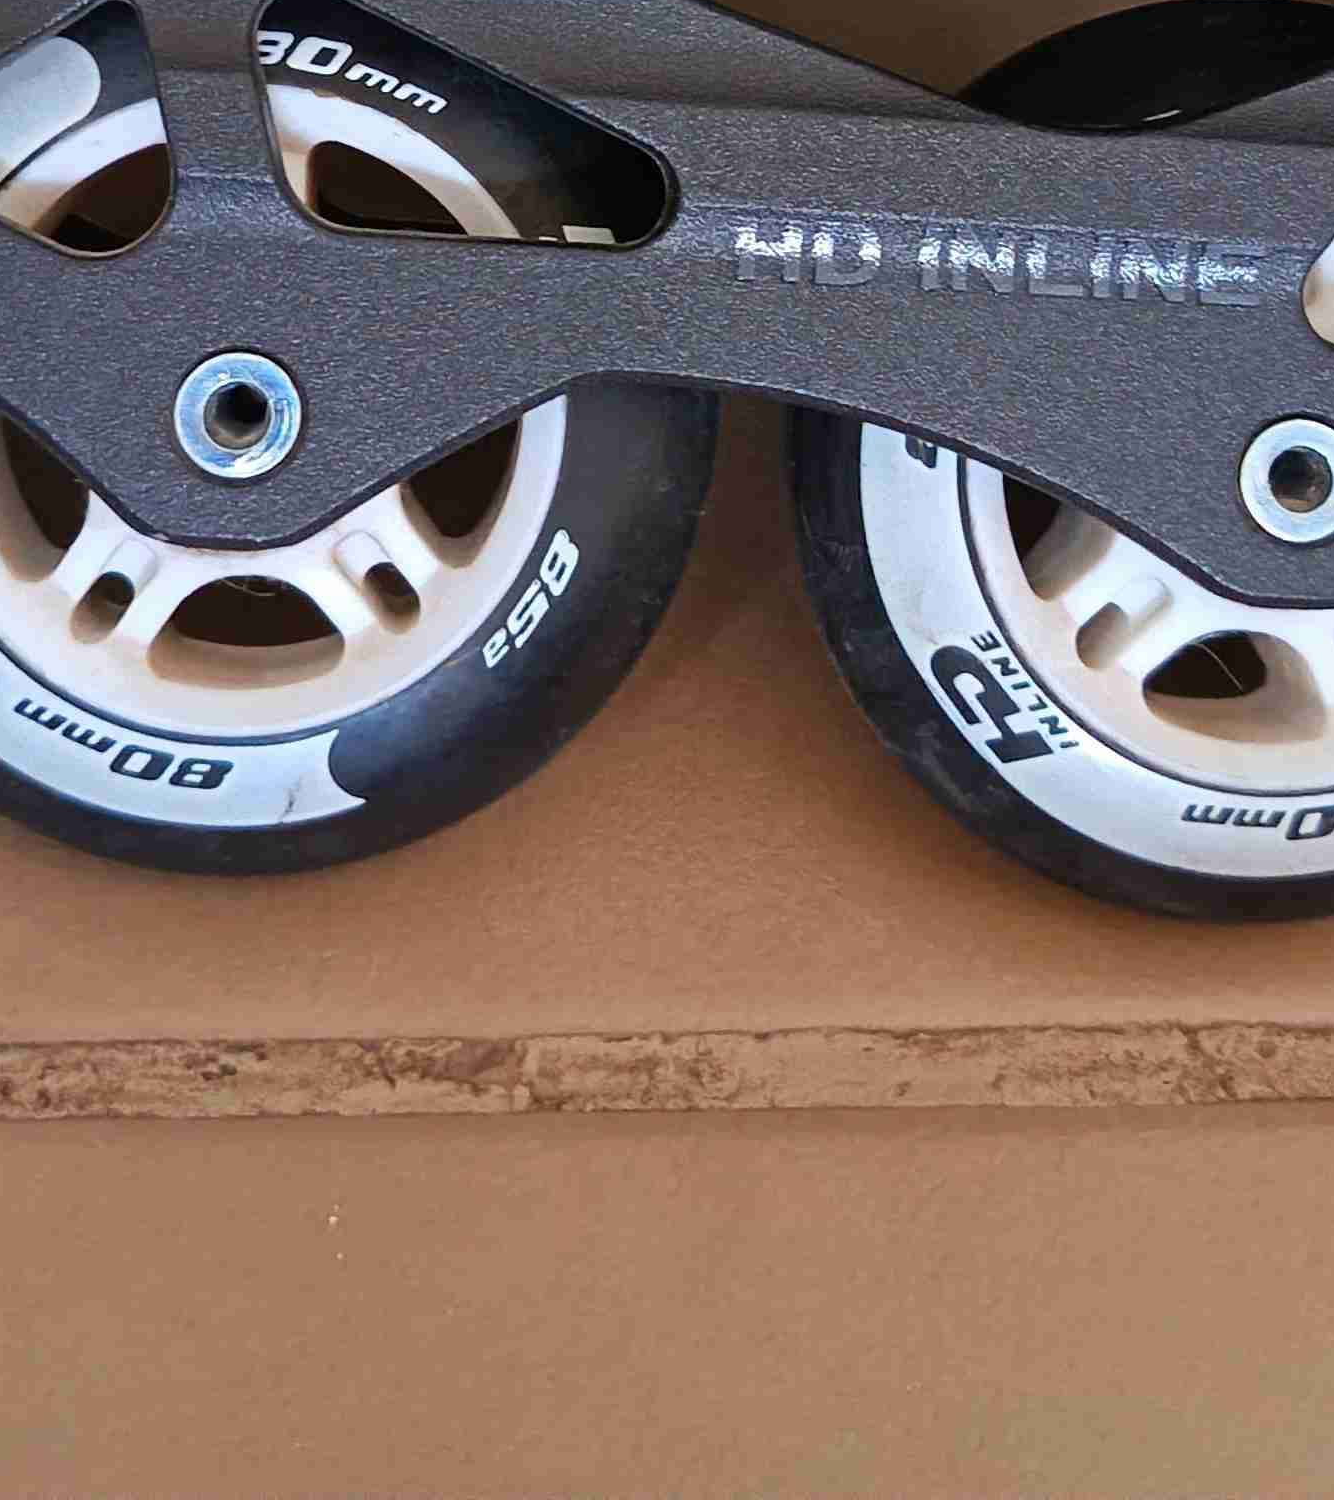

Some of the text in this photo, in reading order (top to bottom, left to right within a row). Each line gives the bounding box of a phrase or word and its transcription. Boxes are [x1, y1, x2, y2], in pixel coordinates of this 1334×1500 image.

[734, 221, 1264, 306] HD INLINE
[480, 528, 582, 670] 85a
[12, 695, 236, 791] 80mm
[971, 631, 1080, 749] INLINE
